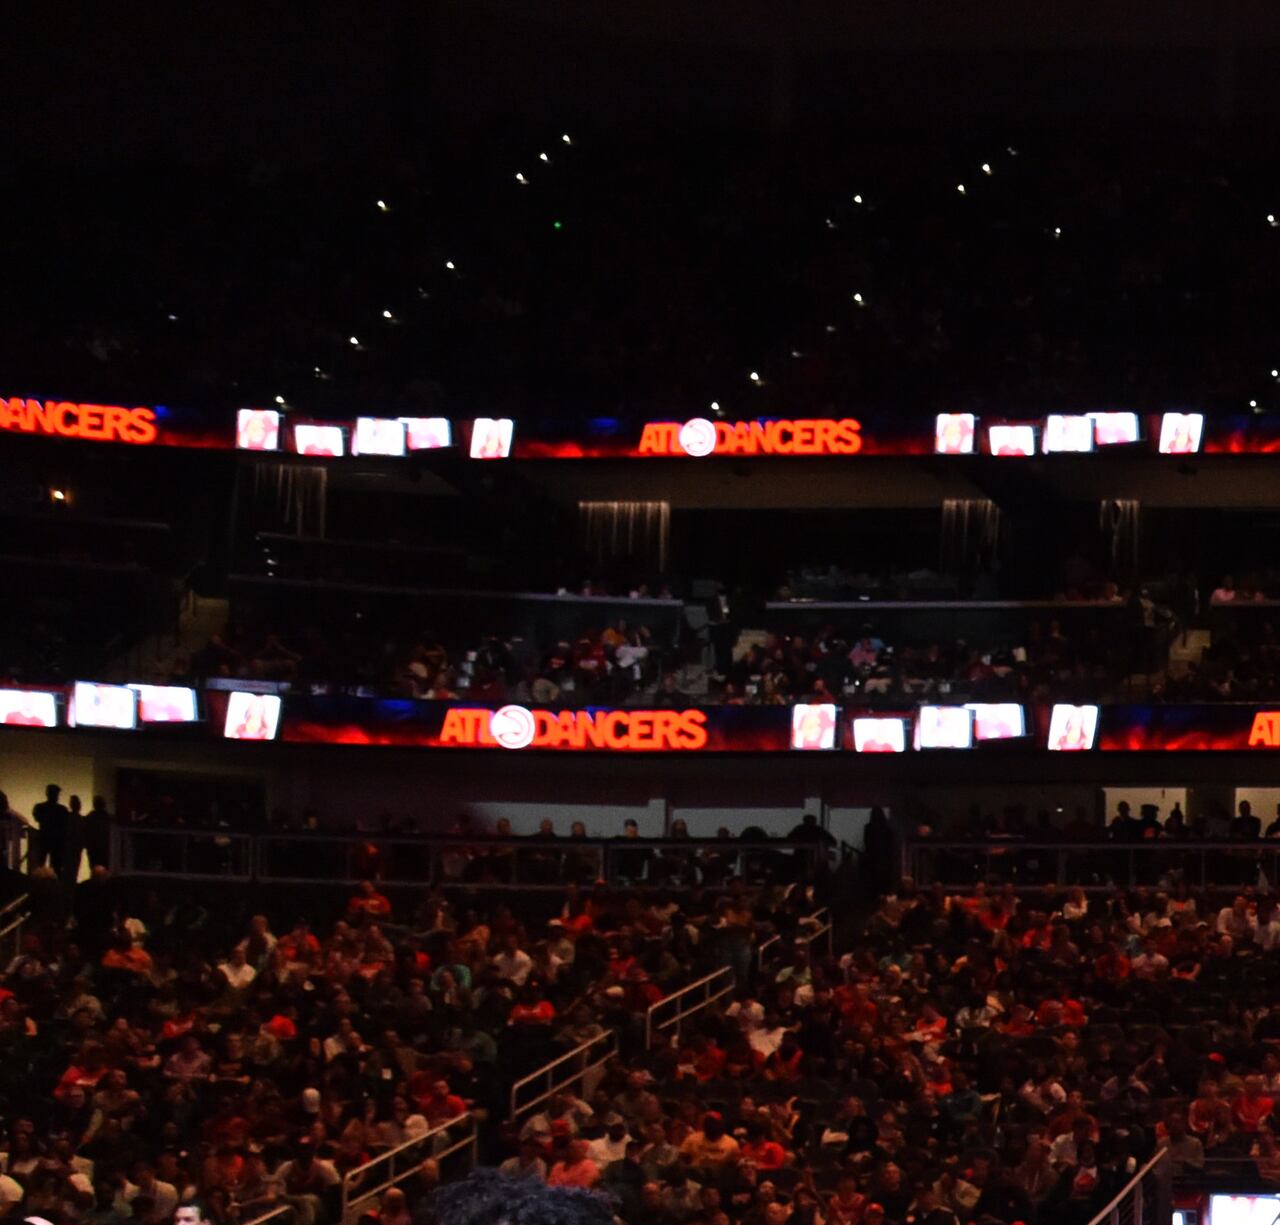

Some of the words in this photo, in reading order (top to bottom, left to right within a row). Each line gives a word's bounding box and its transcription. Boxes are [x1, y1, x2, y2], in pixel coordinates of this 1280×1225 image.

[0, 397, 157, 443] ANCERS
[715, 419, 863, 454] DANCERS
[533, 710, 708, 750] DANCERS
